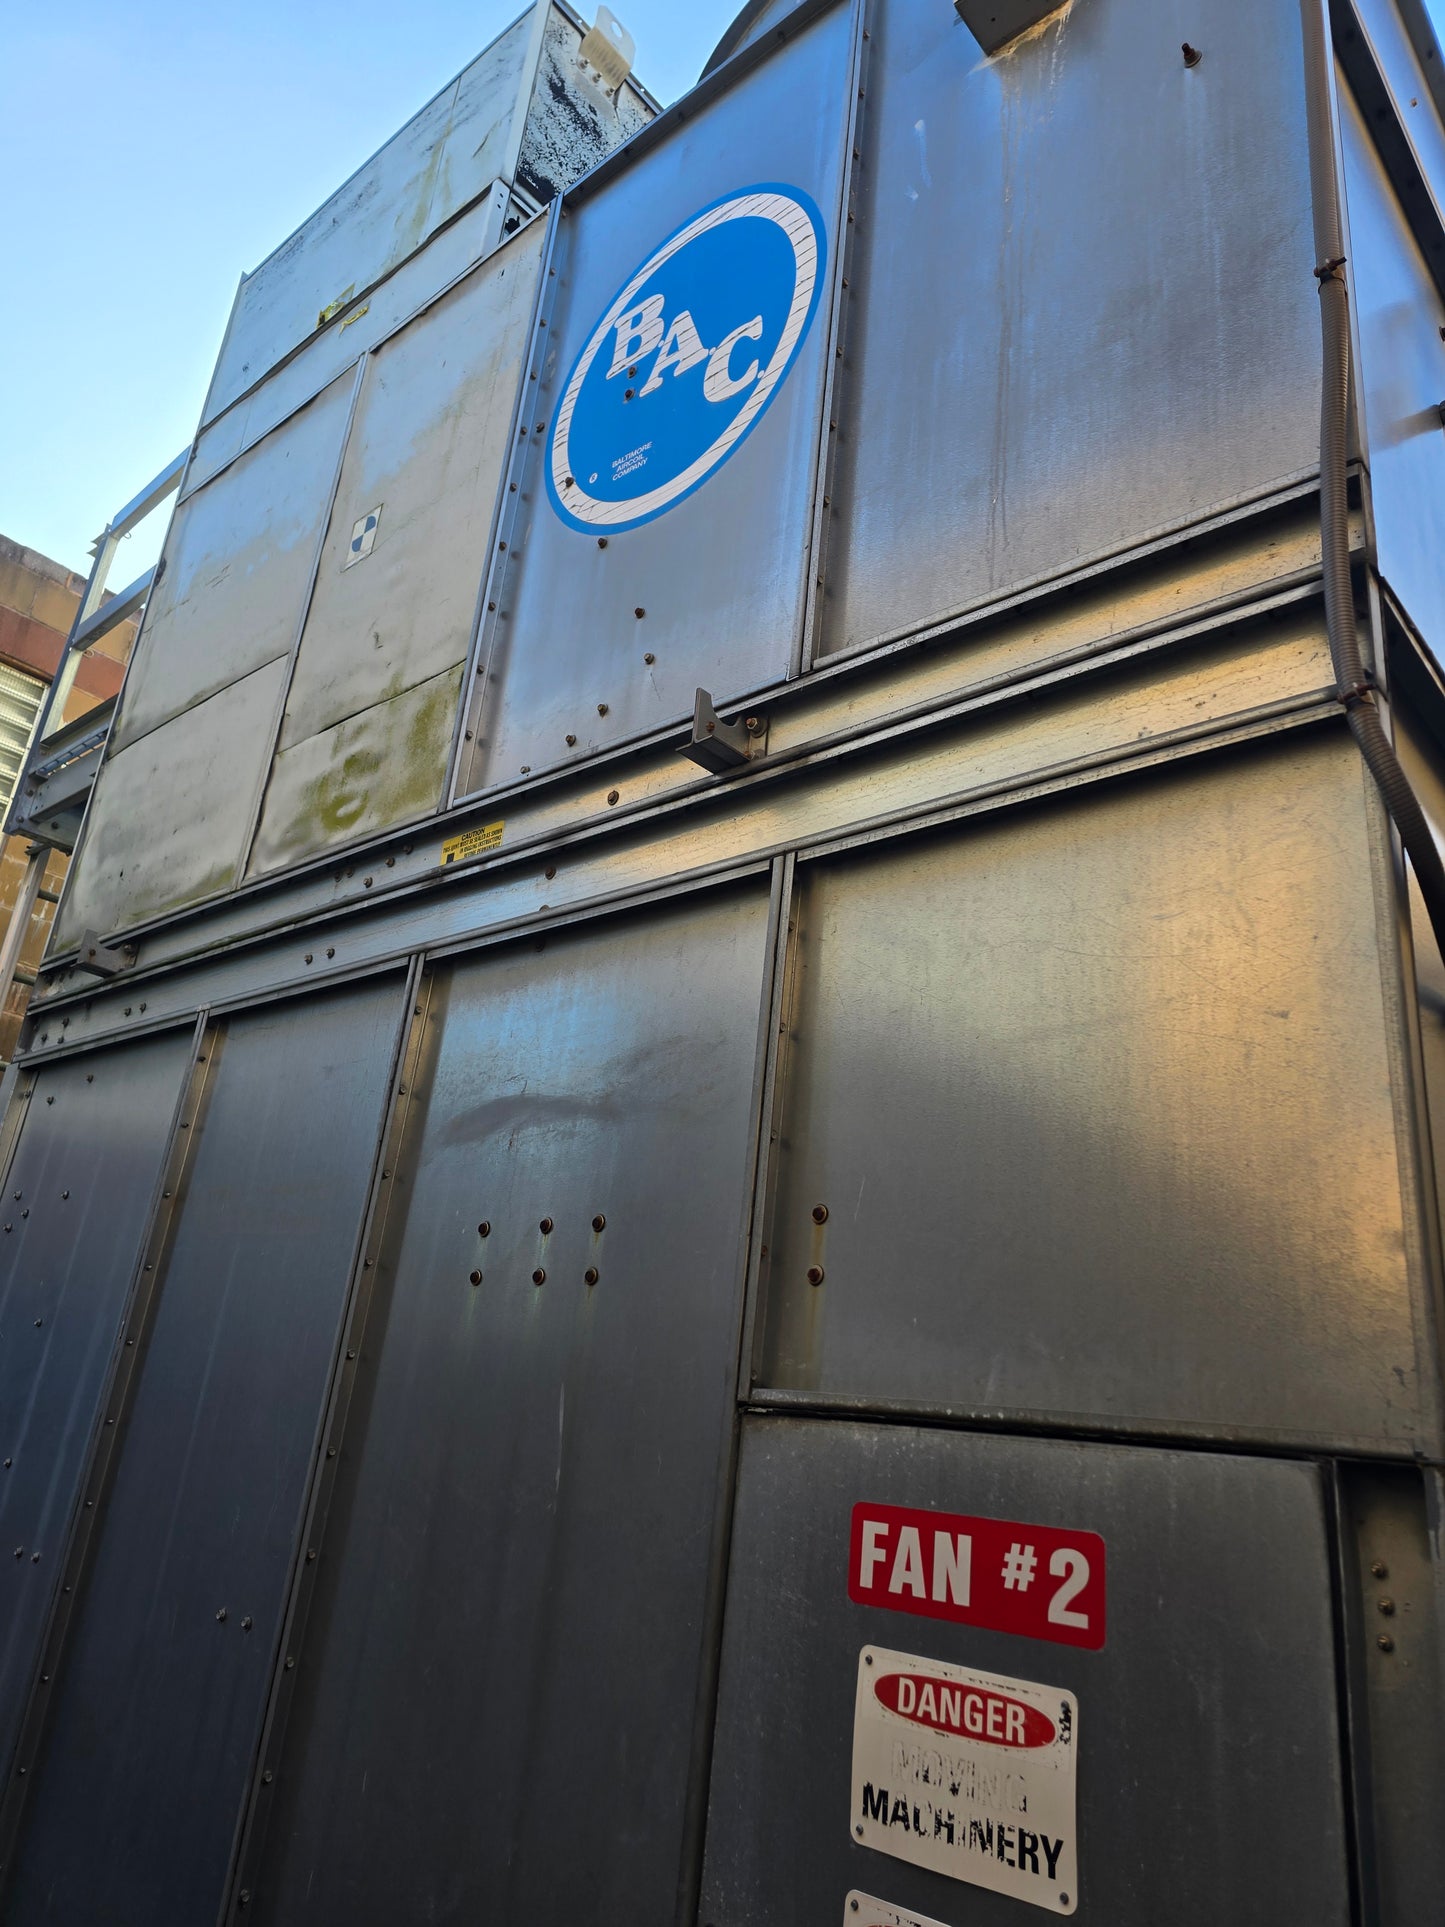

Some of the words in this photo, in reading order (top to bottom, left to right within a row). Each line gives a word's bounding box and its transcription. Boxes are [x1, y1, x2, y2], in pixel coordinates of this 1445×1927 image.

[612, 441, 653, 468] BALTIMORE
[616, 453, 645, 473] AIRCOIL
[612, 457, 648, 481] COMPANY
[461, 827, 486, 841] CAUTION
[859, 1520, 972, 1607] FAN
[1001, 1542, 1090, 1630] #2
[897, 1676, 1026, 1744] DANGER
[862, 1780, 1064, 1880] MACHINERY
